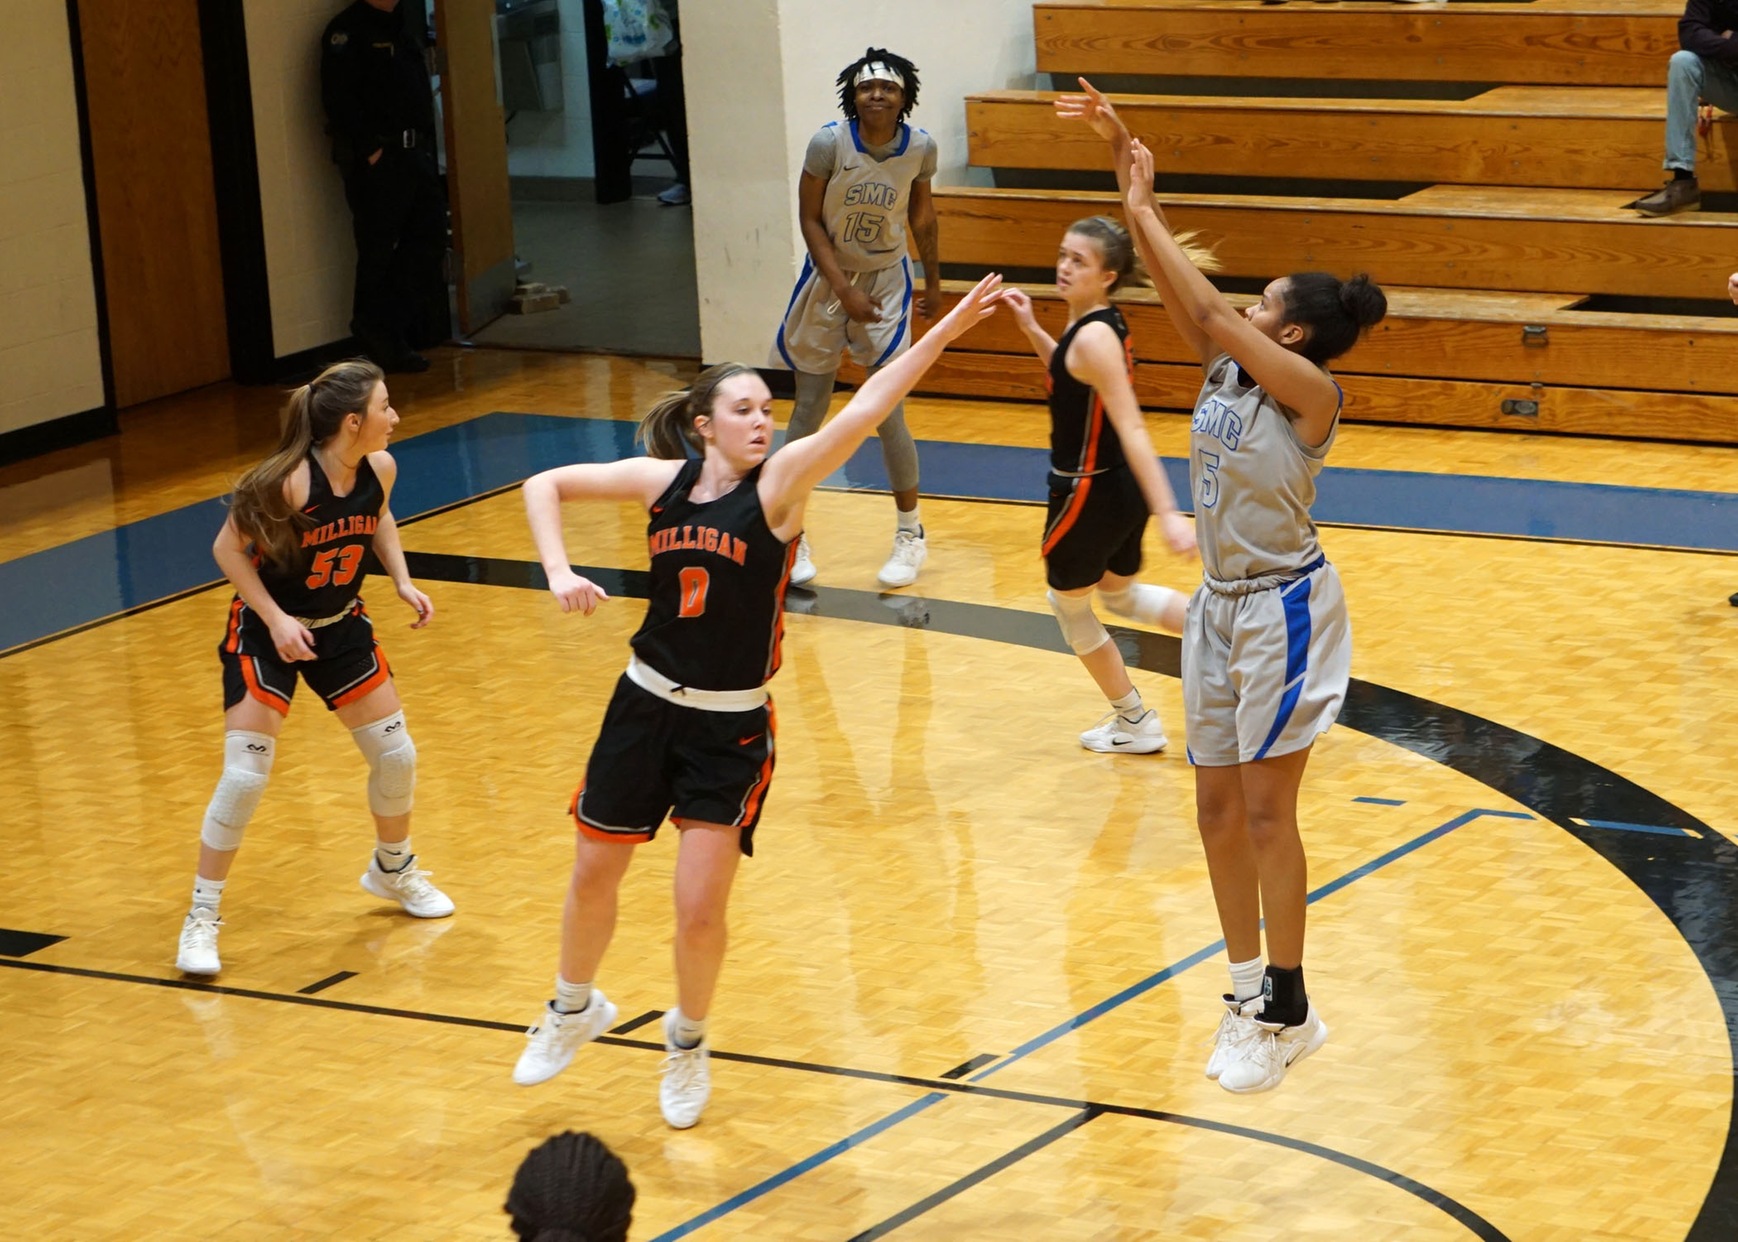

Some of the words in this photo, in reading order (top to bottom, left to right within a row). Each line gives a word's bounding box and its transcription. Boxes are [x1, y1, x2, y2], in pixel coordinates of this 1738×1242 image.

[844, 182, 897, 211] SMC
[843, 212, 884, 243] 15
[1191, 399, 1242, 451] SMC
[1199, 449, 1219, 508] 5
[305, 544, 364, 590] 53
[650, 525, 748, 566] MILLIGAN
[678, 566, 709, 618] 0
